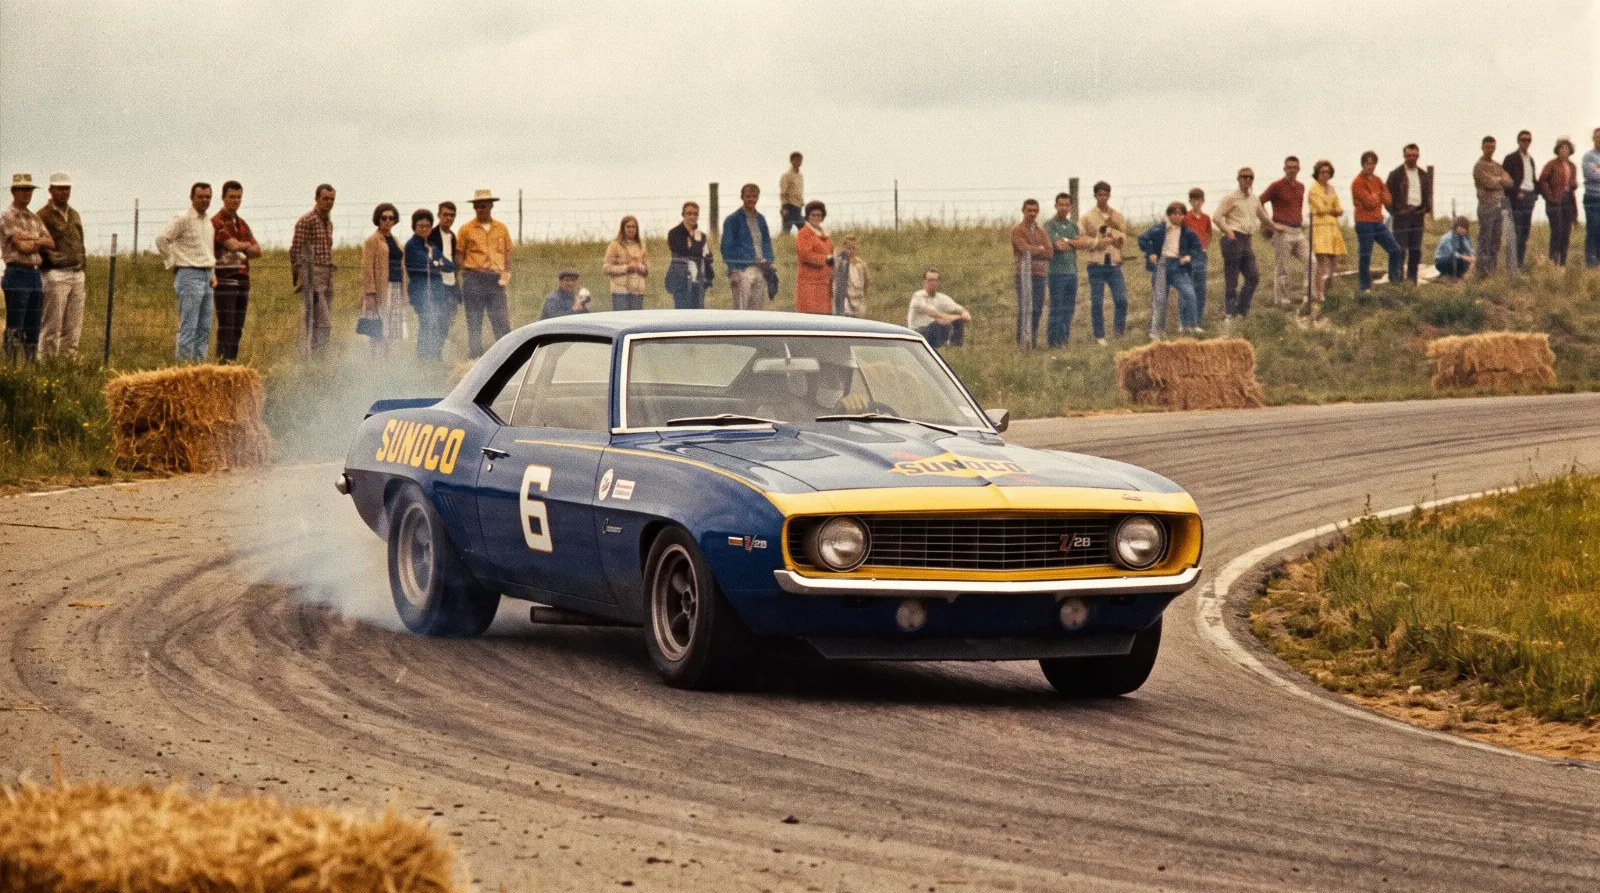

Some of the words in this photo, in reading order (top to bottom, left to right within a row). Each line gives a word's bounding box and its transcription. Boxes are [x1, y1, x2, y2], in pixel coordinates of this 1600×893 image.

[376, 419, 466, 475] SUNOCO
[898, 460, 1026, 474] SUNOCO
[520, 464, 553, 553] 6
